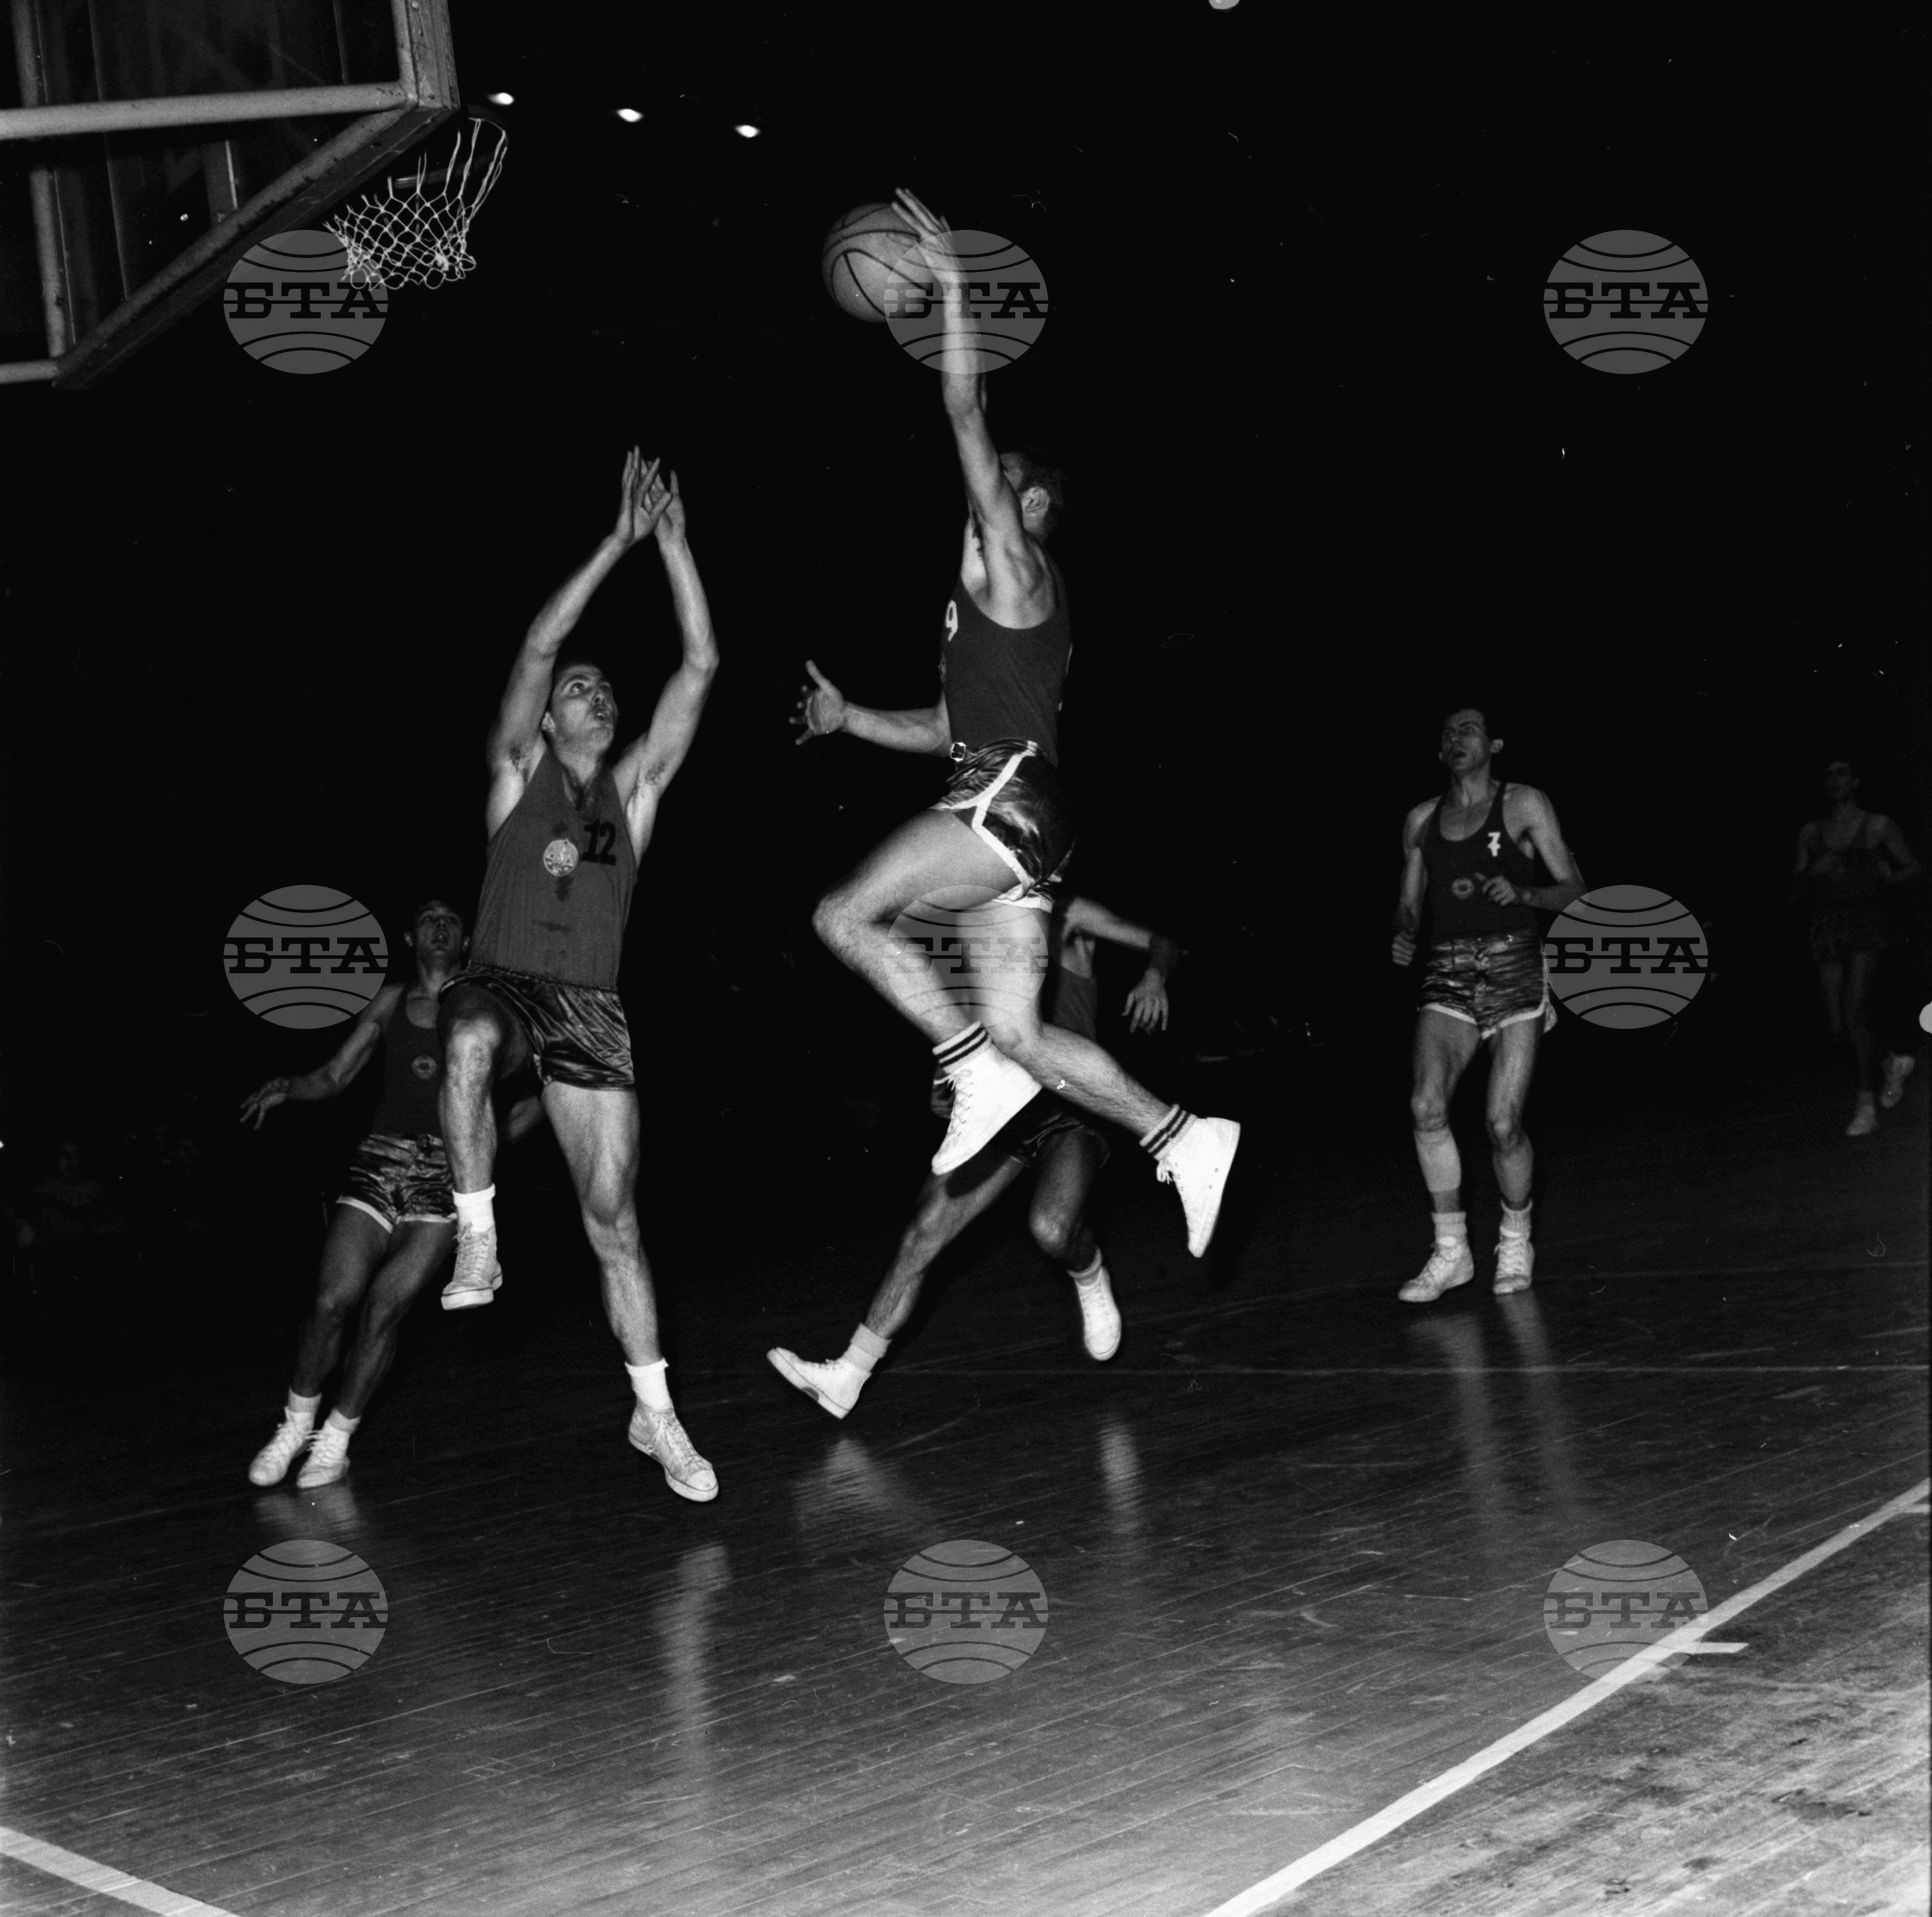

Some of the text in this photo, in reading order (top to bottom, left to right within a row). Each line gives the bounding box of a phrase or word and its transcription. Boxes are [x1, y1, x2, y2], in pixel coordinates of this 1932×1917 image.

[945, 600, 958, 642] 9
[582, 819, 616, 865] 12
[1487, 831, 1501, 857] 7
